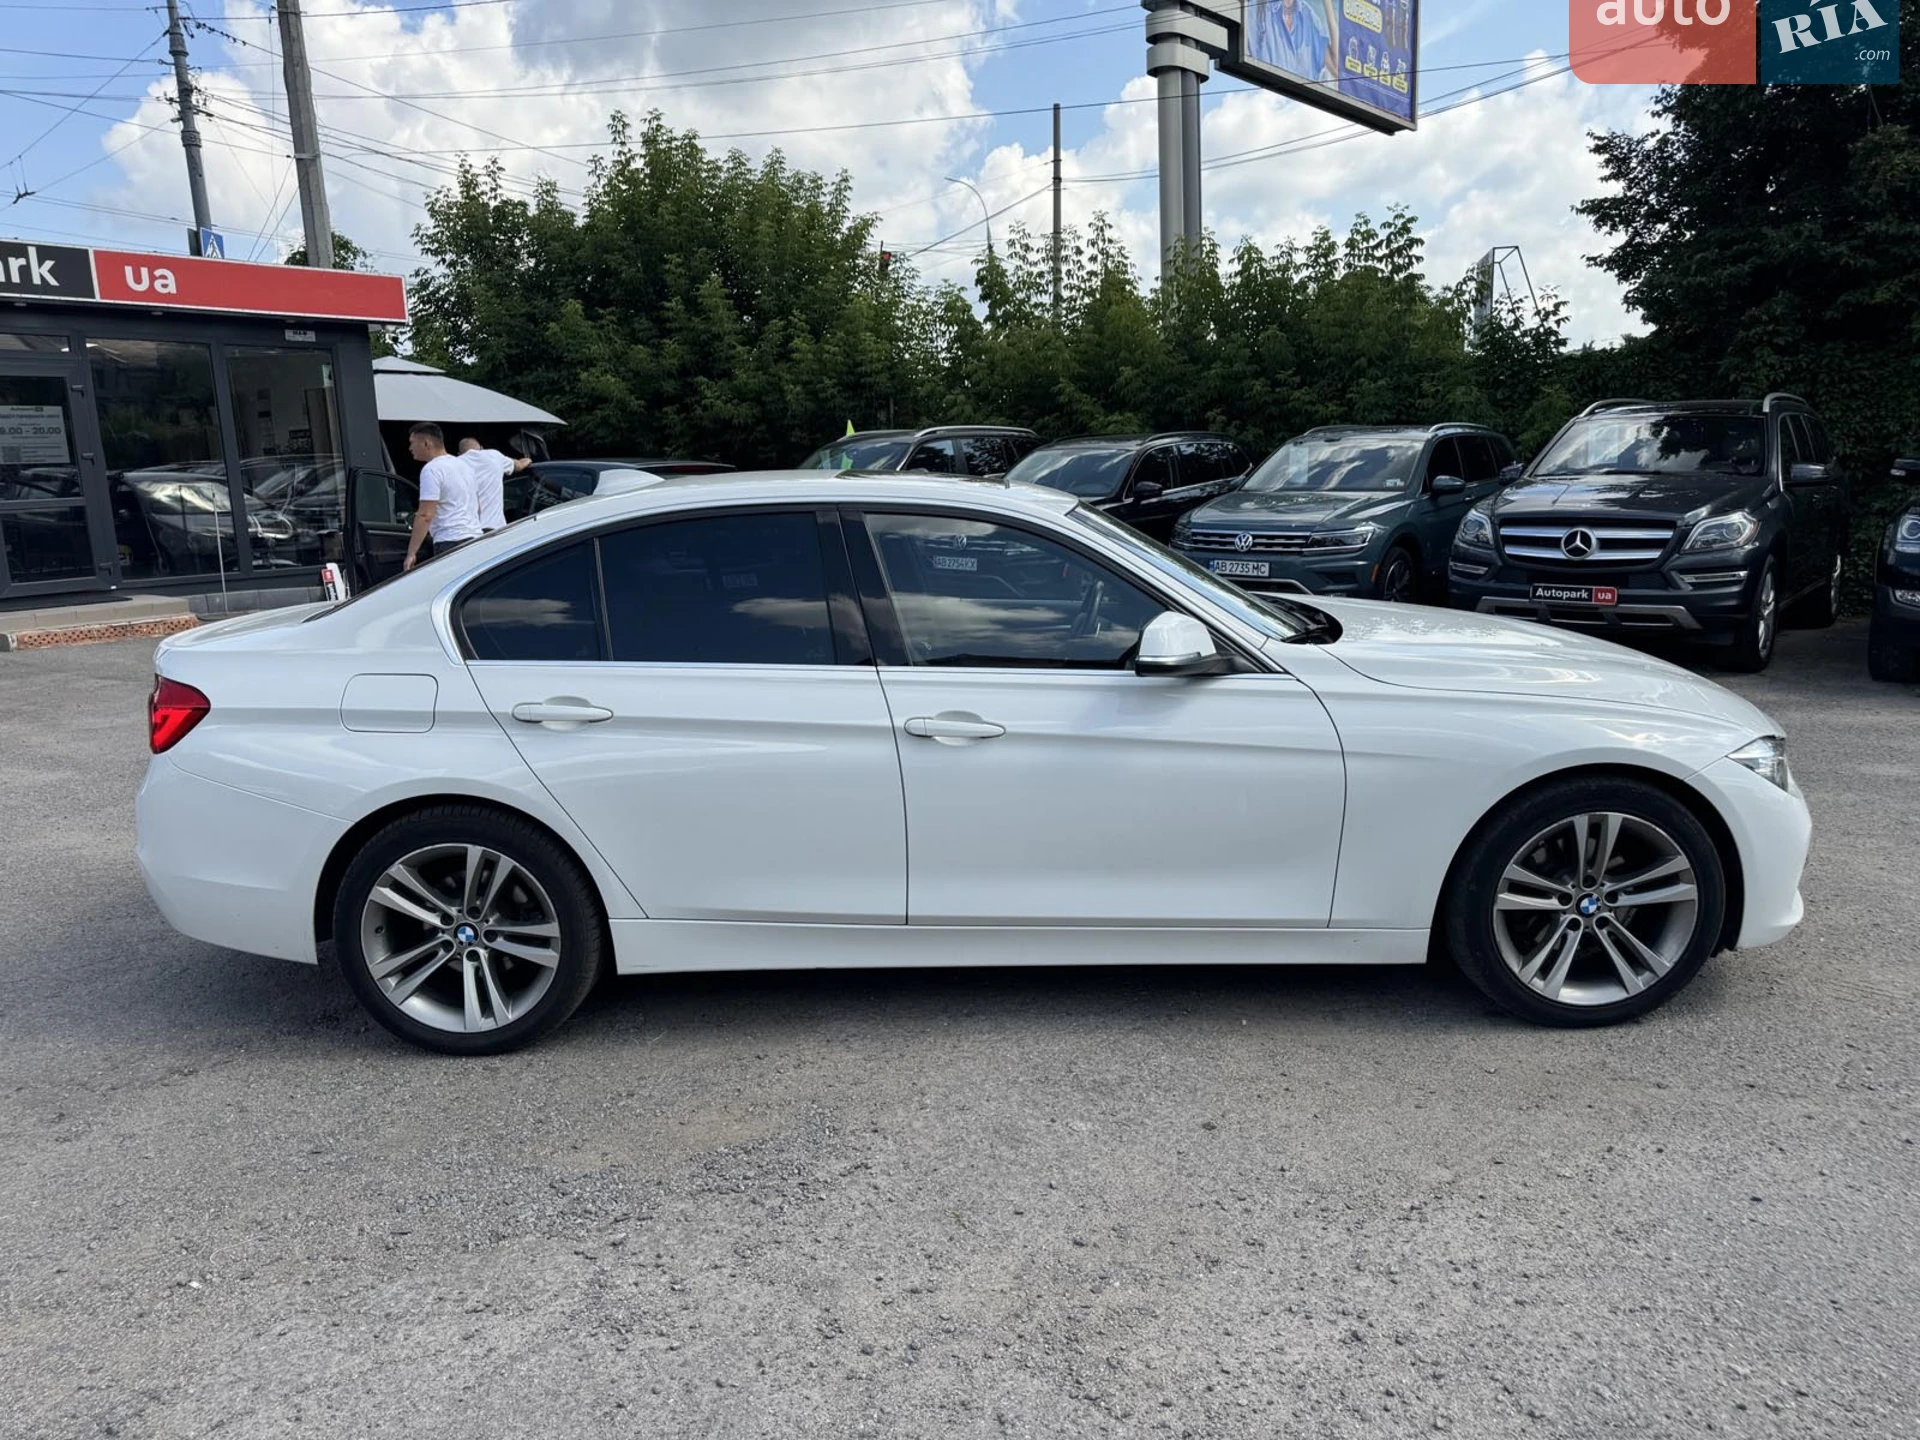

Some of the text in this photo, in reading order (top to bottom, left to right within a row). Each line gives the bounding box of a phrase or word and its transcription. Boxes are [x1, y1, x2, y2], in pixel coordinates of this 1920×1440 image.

[0, 245, 177, 294] rk ua
[1214, 561, 1266, 575] AB 2735 MC
[1535, 587, 1612, 600] Autopark ua
